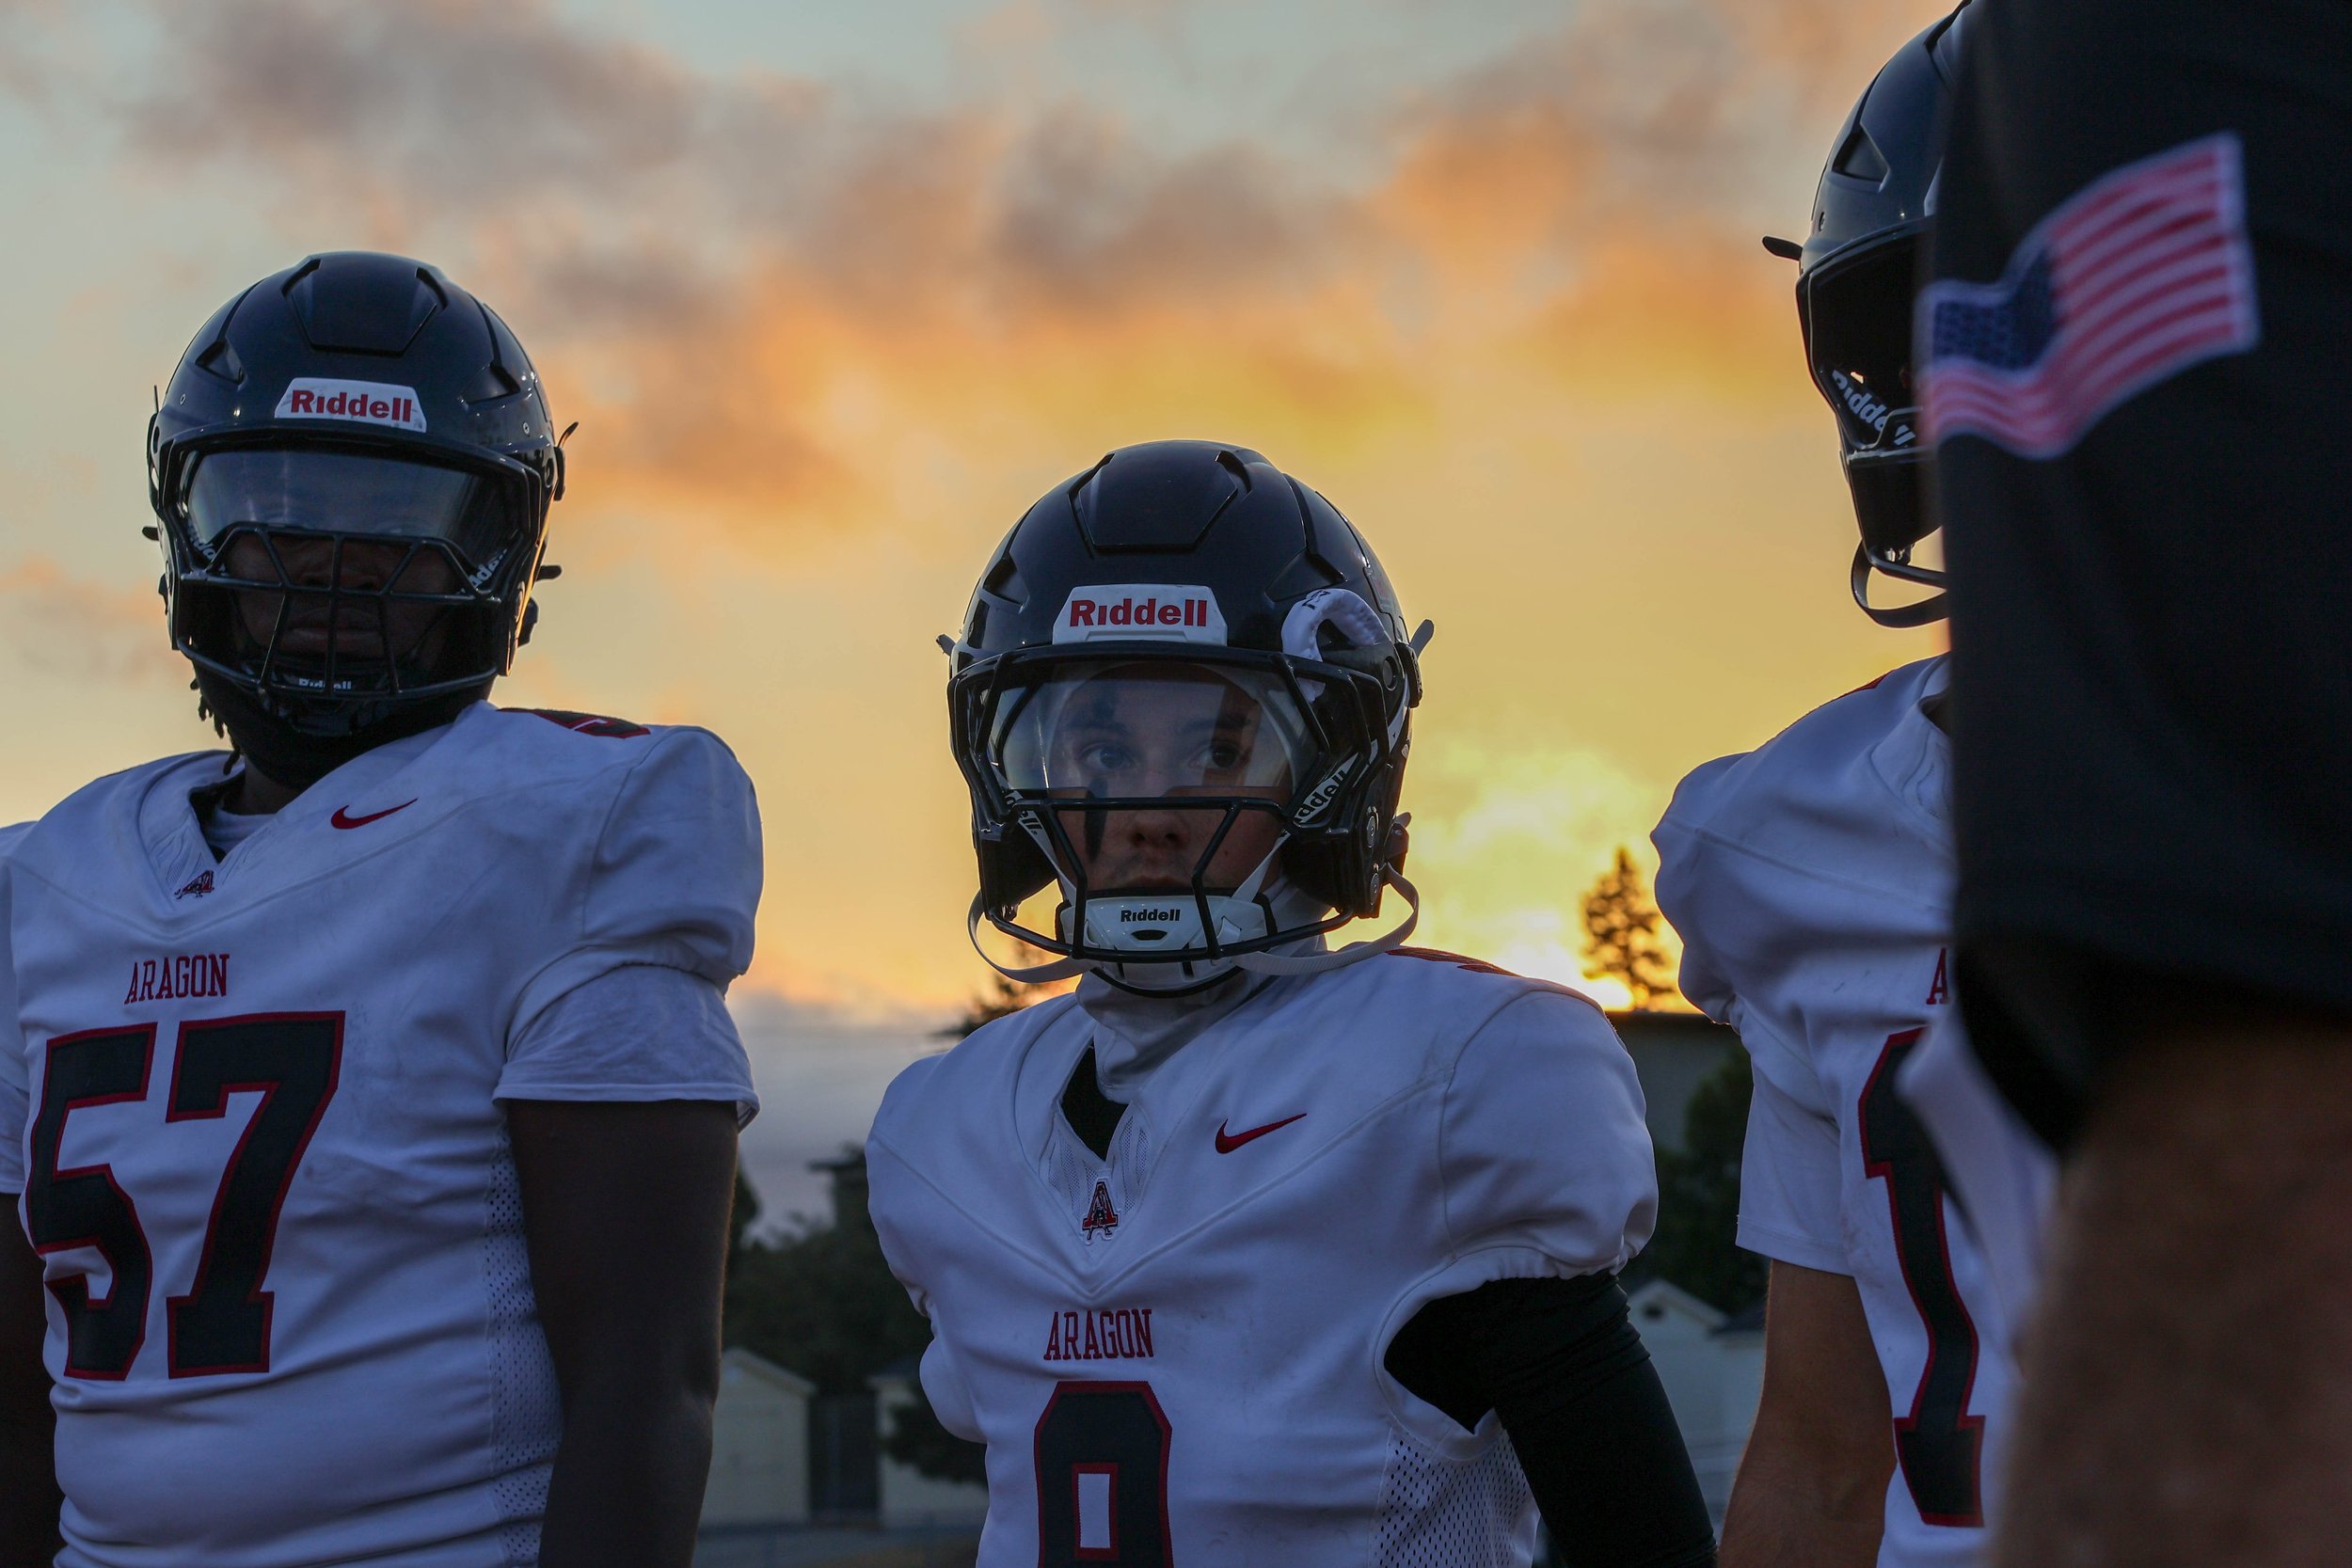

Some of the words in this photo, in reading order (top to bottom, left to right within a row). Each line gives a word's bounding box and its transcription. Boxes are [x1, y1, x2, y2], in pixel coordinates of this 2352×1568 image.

[291, 388, 412, 423] Riddell
[1069, 598, 1208, 628] Riddell
[1120, 908, 1182, 923] Riddell
[124, 954, 230, 1005] ARAGON
[25, 1010, 345, 1381] 57
[1043, 1308, 1154, 1361] ARAGON
